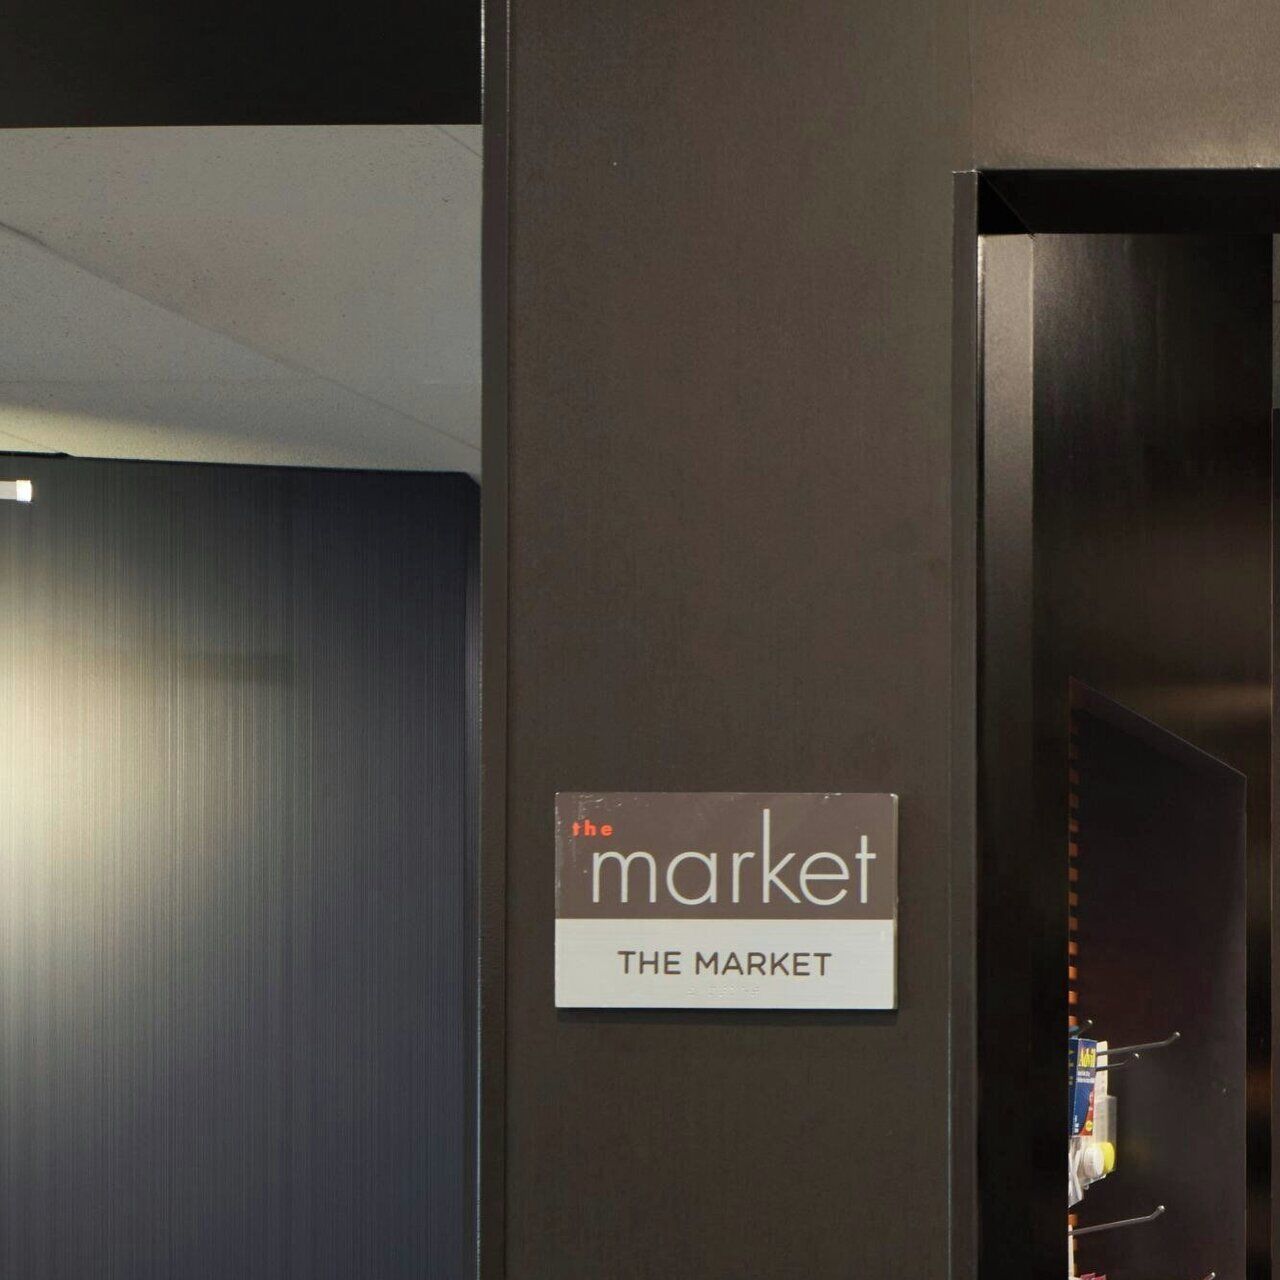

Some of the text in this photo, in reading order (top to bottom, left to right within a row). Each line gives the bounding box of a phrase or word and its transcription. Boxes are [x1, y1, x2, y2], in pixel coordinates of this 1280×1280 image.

[572, 819, 613, 837] the
[592, 808, 877, 906] market
[617, 950, 833, 977] THE MARKET
